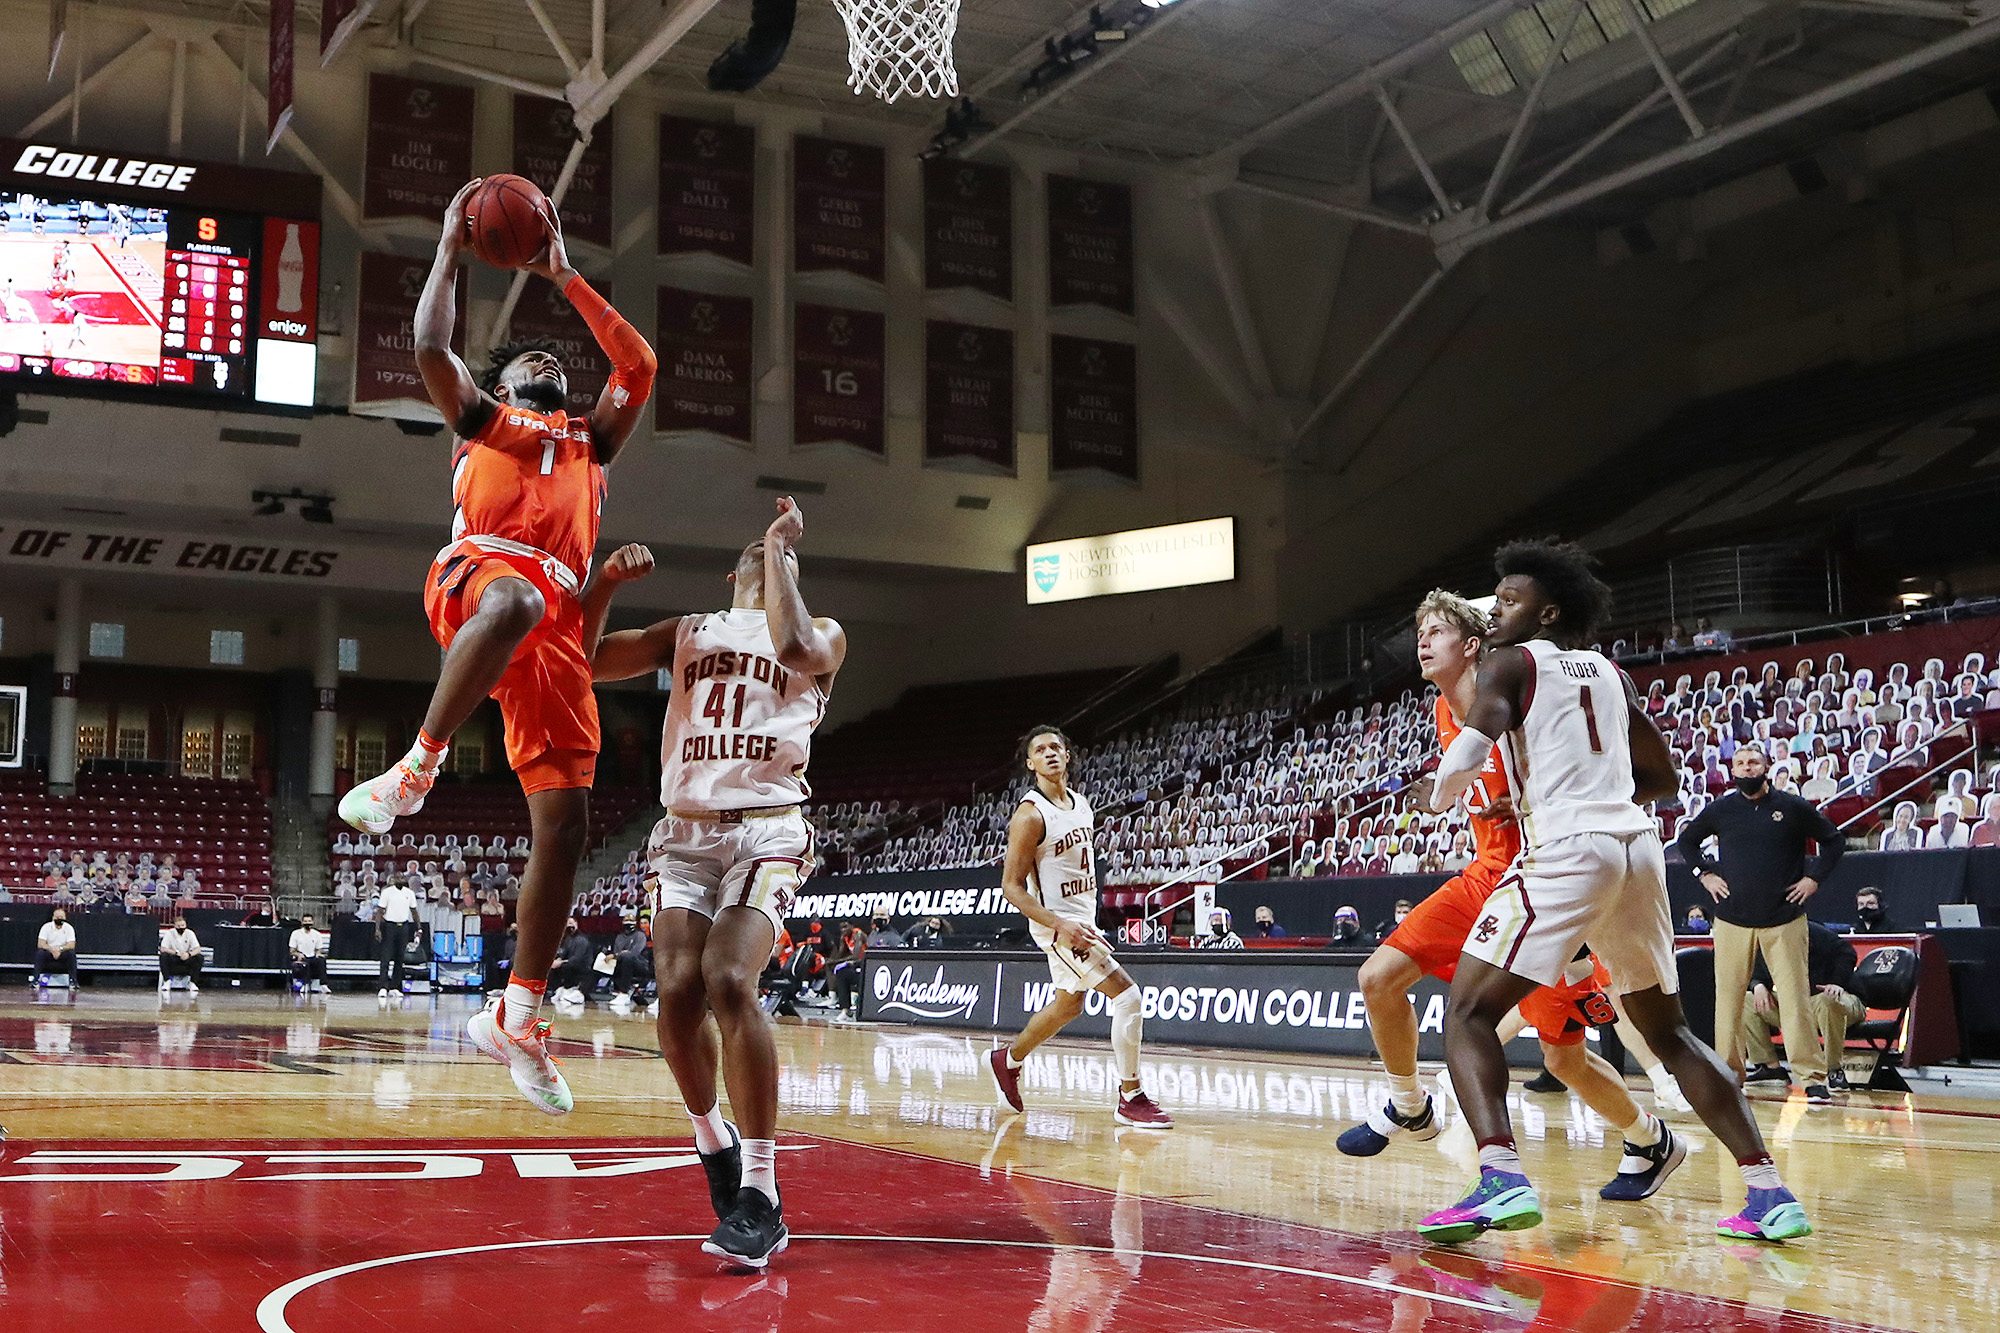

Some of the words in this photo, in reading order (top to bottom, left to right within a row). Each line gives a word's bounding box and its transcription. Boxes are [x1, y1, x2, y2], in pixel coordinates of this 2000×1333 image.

[408, 141, 432, 155] JIM
[13, 145, 197, 191] COLLEGE
[391, 153, 448, 174] LOGUE
[198, 217, 217, 241] S
[268, 319, 307, 337] enjoy
[675, 363, 734, 382] BARROS
[683, 350, 726, 367] DANA
[821, 369, 859, 396] 16
[539, 438, 556, 475] 1
[9, 528, 71, 558] OF
[81, 533, 164, 565] THE
[175, 541, 339, 577] EAGLES
[1069, 560, 1137, 581] HOSPITAL
[683, 651, 788, 698] BOSTON
[1559, 660, 1600, 679] FELDER
[703, 683, 746, 728] 41
[1580, 685, 1604, 754] 1
[682, 734, 777, 763] COLLEGE
[1080, 847, 1090, 875] 4
[1060, 876, 1097, 898] COLLE
[793, 894, 839, 919] MOVE
[835, 891, 899, 918] BOSTON
[900, 888, 979, 916] COLLEGE
[891, 964, 979, 1021] Academy
[1140, 985, 1259, 1025] BOSTON
[1584, 993, 1617, 1024] S
